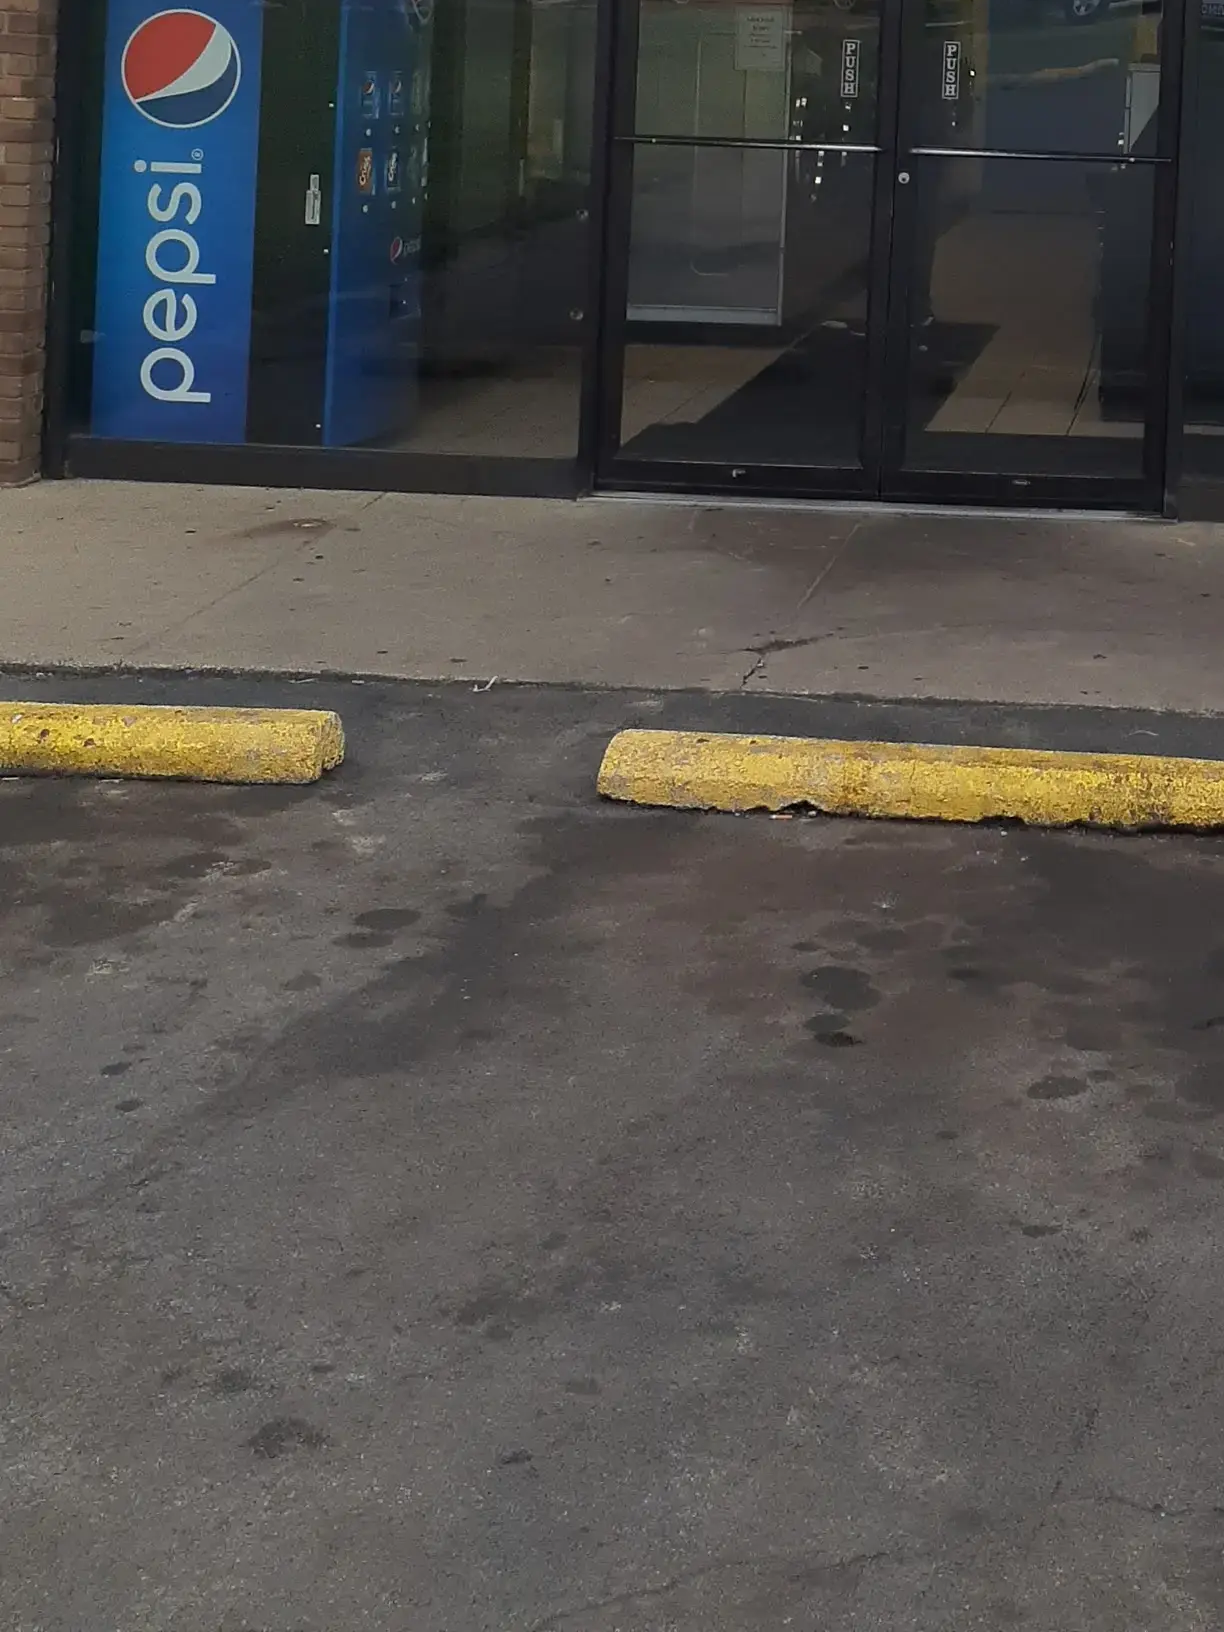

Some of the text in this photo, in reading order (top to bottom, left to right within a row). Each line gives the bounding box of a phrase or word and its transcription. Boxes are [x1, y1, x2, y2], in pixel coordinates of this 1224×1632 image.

[843, 42, 857, 95] PUSH
[944, 44, 958, 97] PUSH
[133, 159, 216, 403] pepsi
